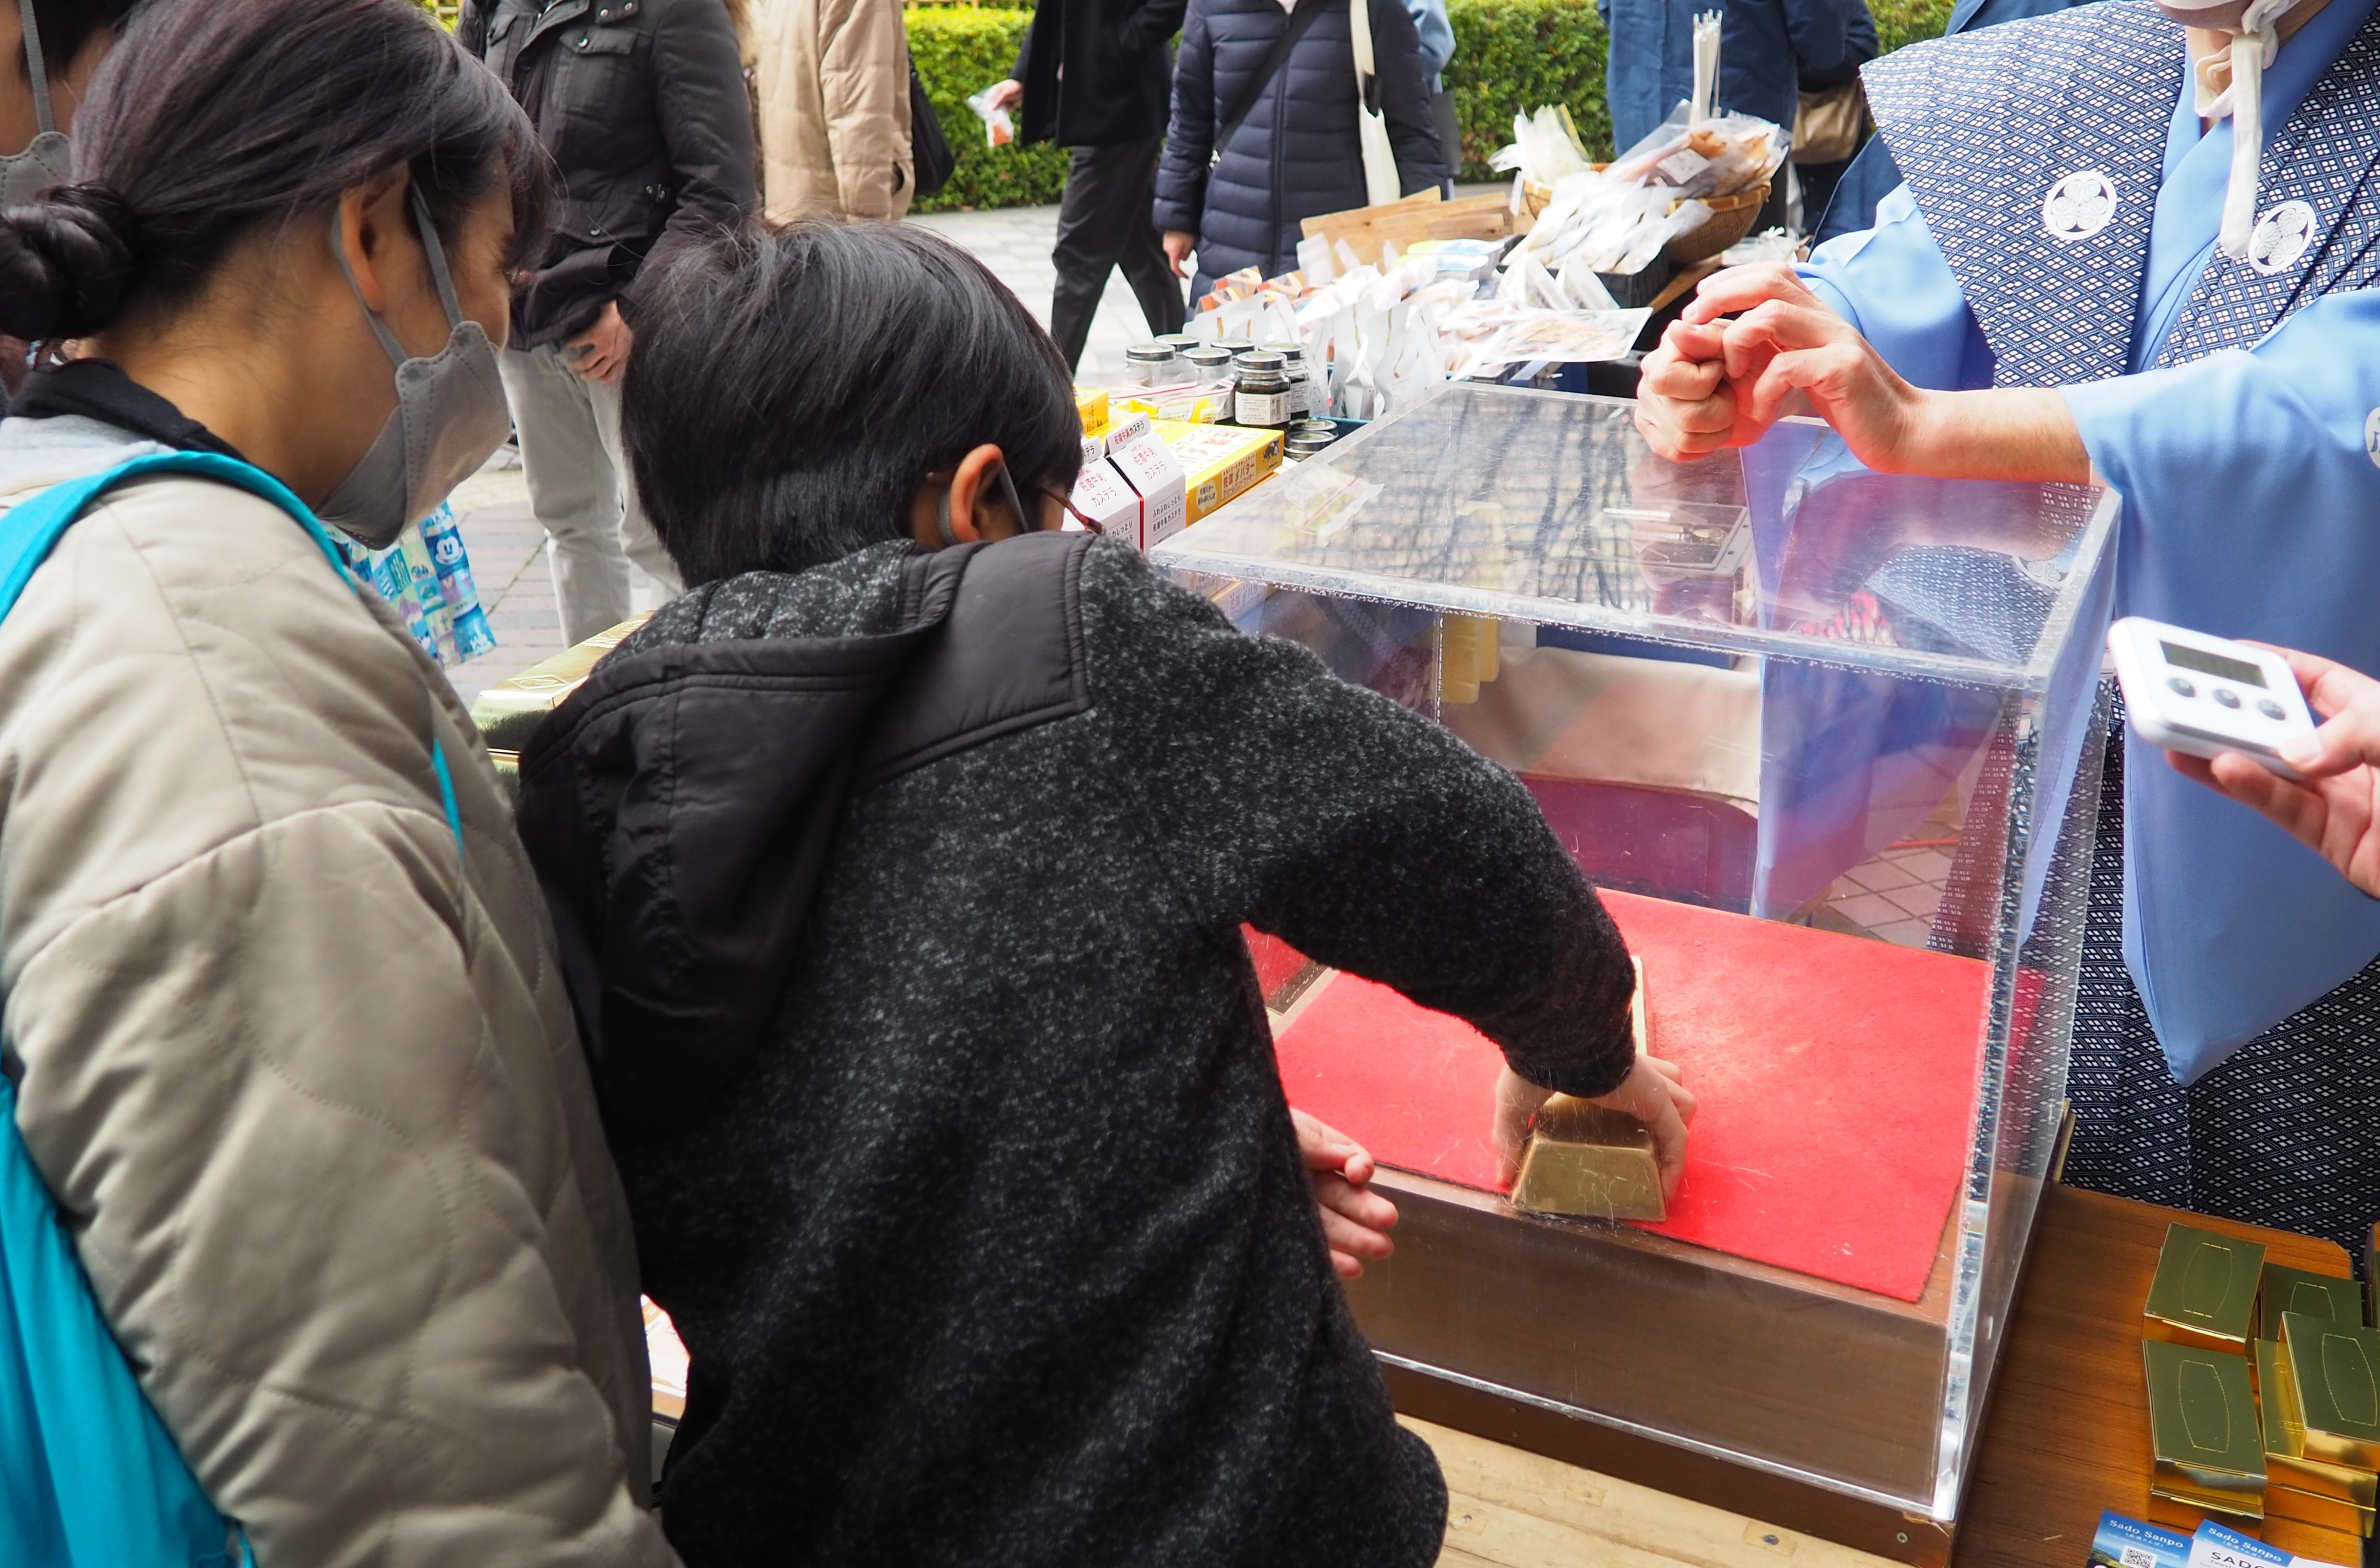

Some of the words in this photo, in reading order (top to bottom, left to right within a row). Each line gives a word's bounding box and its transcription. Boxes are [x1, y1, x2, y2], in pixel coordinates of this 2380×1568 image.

[1145, 461, 1167, 481] カステラ
[1091, 486, 1117, 507] カステラ
[1108, 520, 1133, 537] わしっとり
[2110, 1520, 2140, 1534] Sado
[2144, 1530, 2183, 1548] Sanpo
[2208, 1527, 2239, 1544] Sado
[2242, 1542, 2282, 1562] Sanpo
